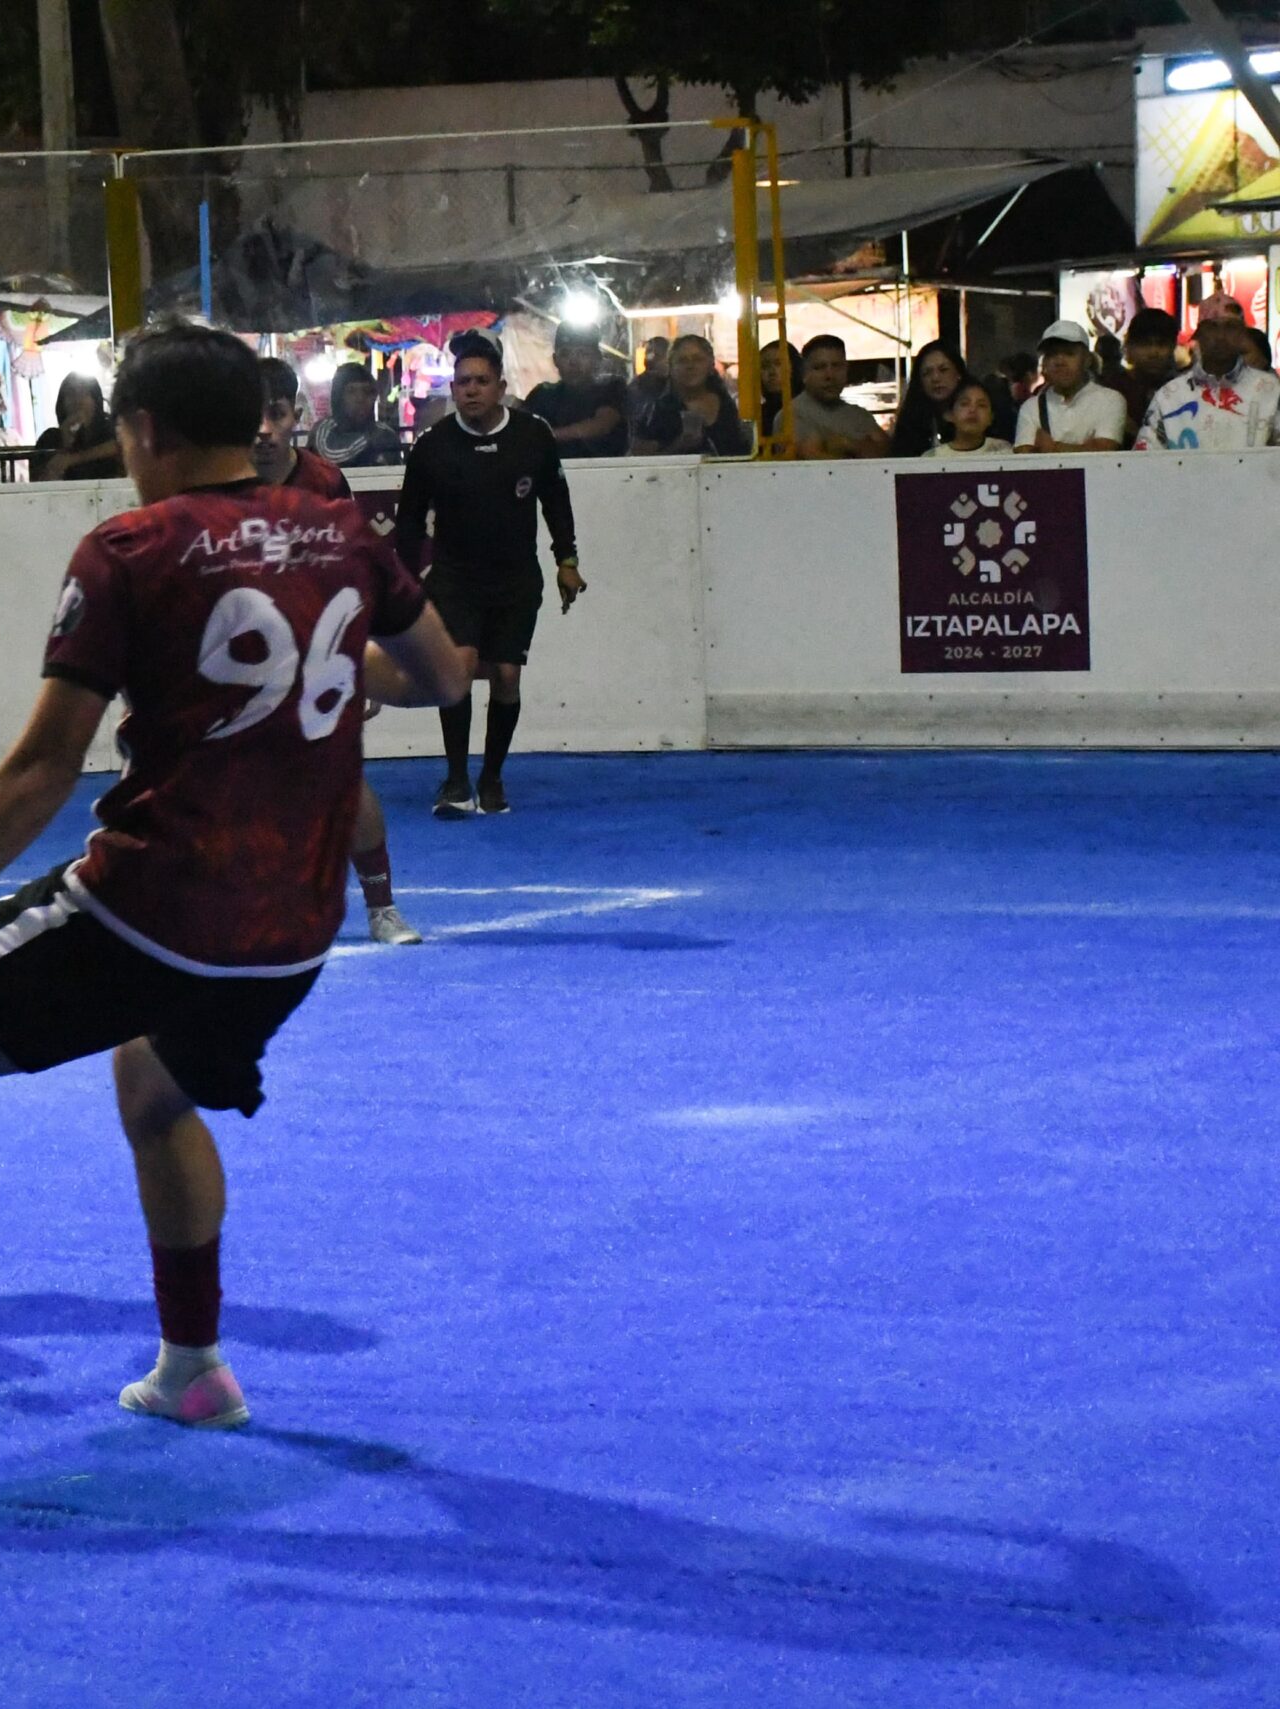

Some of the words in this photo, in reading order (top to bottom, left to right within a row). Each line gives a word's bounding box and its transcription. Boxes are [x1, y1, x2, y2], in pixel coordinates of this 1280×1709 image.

[948, 589, 1035, 606] ALCALDÍA
[906, 613, 1082, 638] IZTAPALAPA
[944, 647, 984, 660] 2024
[1002, 645, 1043, 659] 2027
[197, 587, 365, 742] 96
